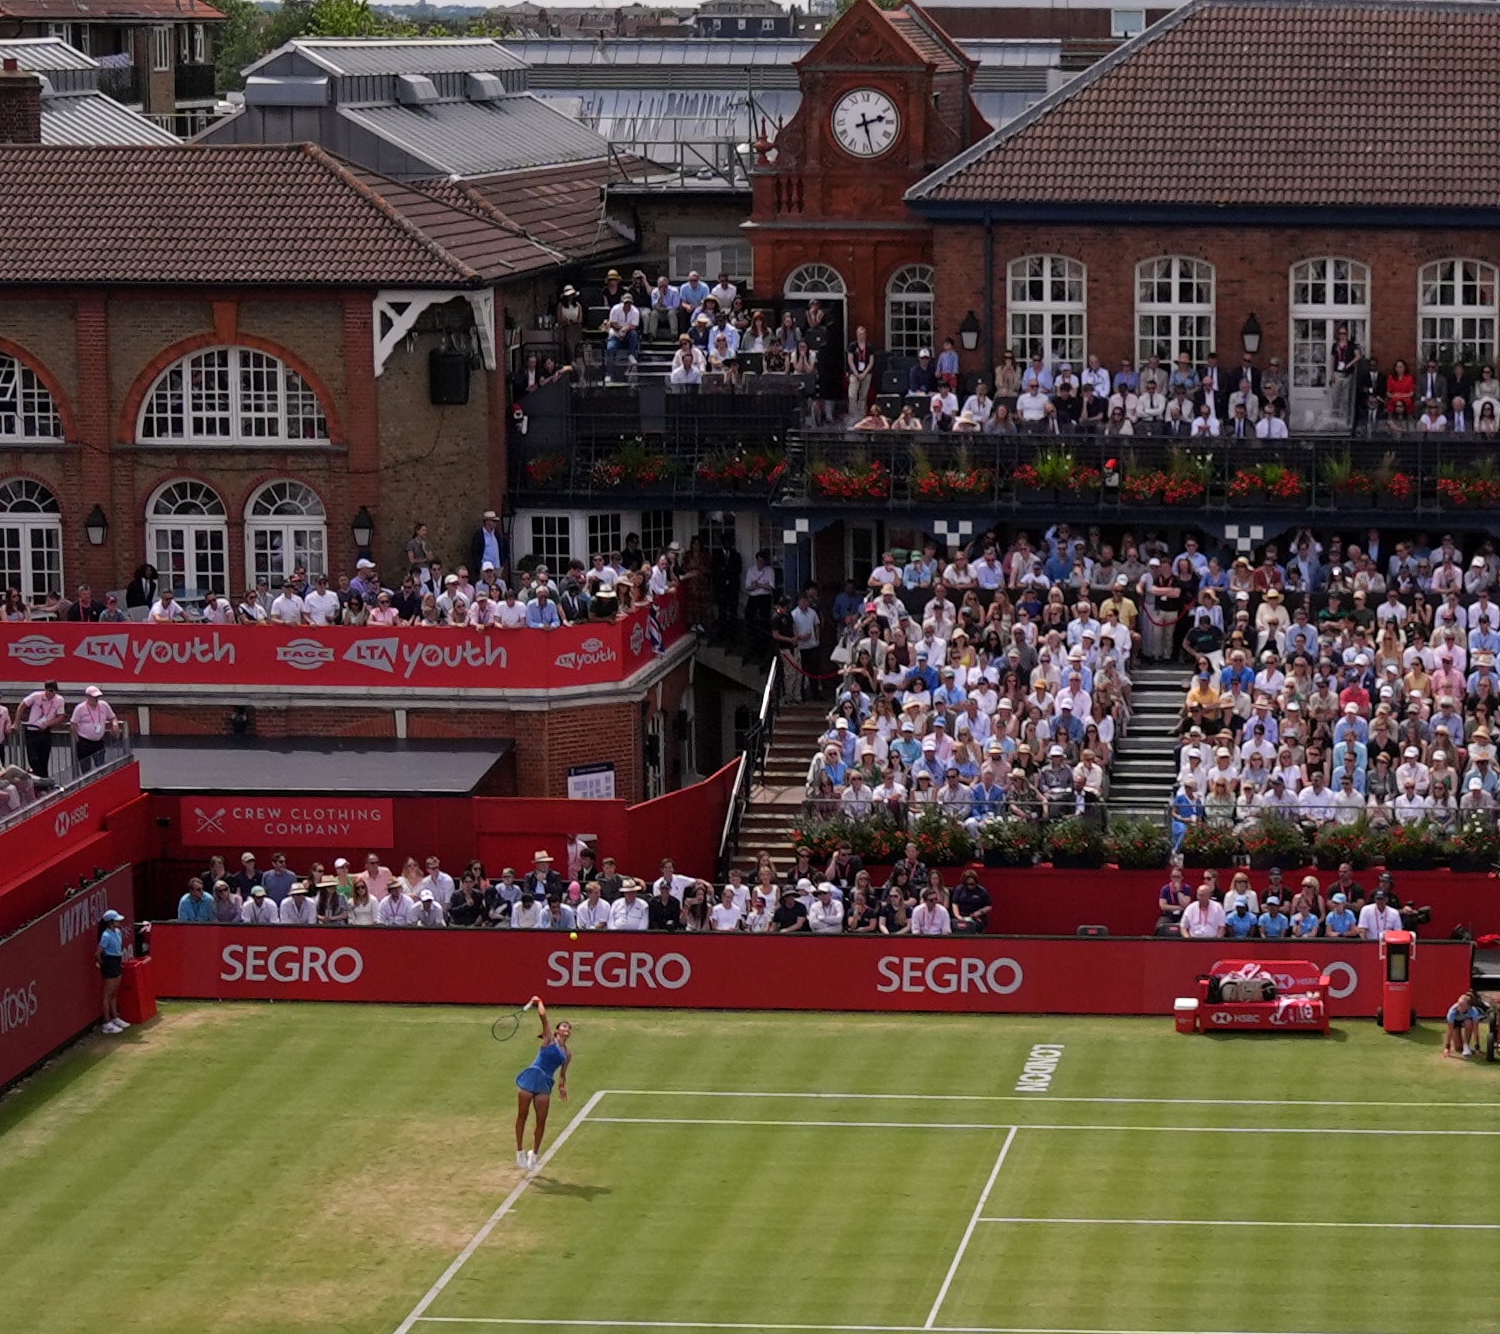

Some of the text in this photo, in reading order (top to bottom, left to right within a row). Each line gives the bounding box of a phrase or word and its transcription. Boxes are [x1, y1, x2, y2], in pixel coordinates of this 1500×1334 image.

[132, 631, 237, 676] youth
[402, 635, 508, 680] youth
[232, 807, 382, 822] CREW CLOTHING
[264, 823, 351, 836] COMPANY
[59, 897, 90, 947] WTA
[220, 943, 364, 984] SEGRO
[546, 950, 692, 990] SEGRO
[876, 955, 1025, 995] SEGRO
[1014, 1043, 1066, 1092] LONDON
